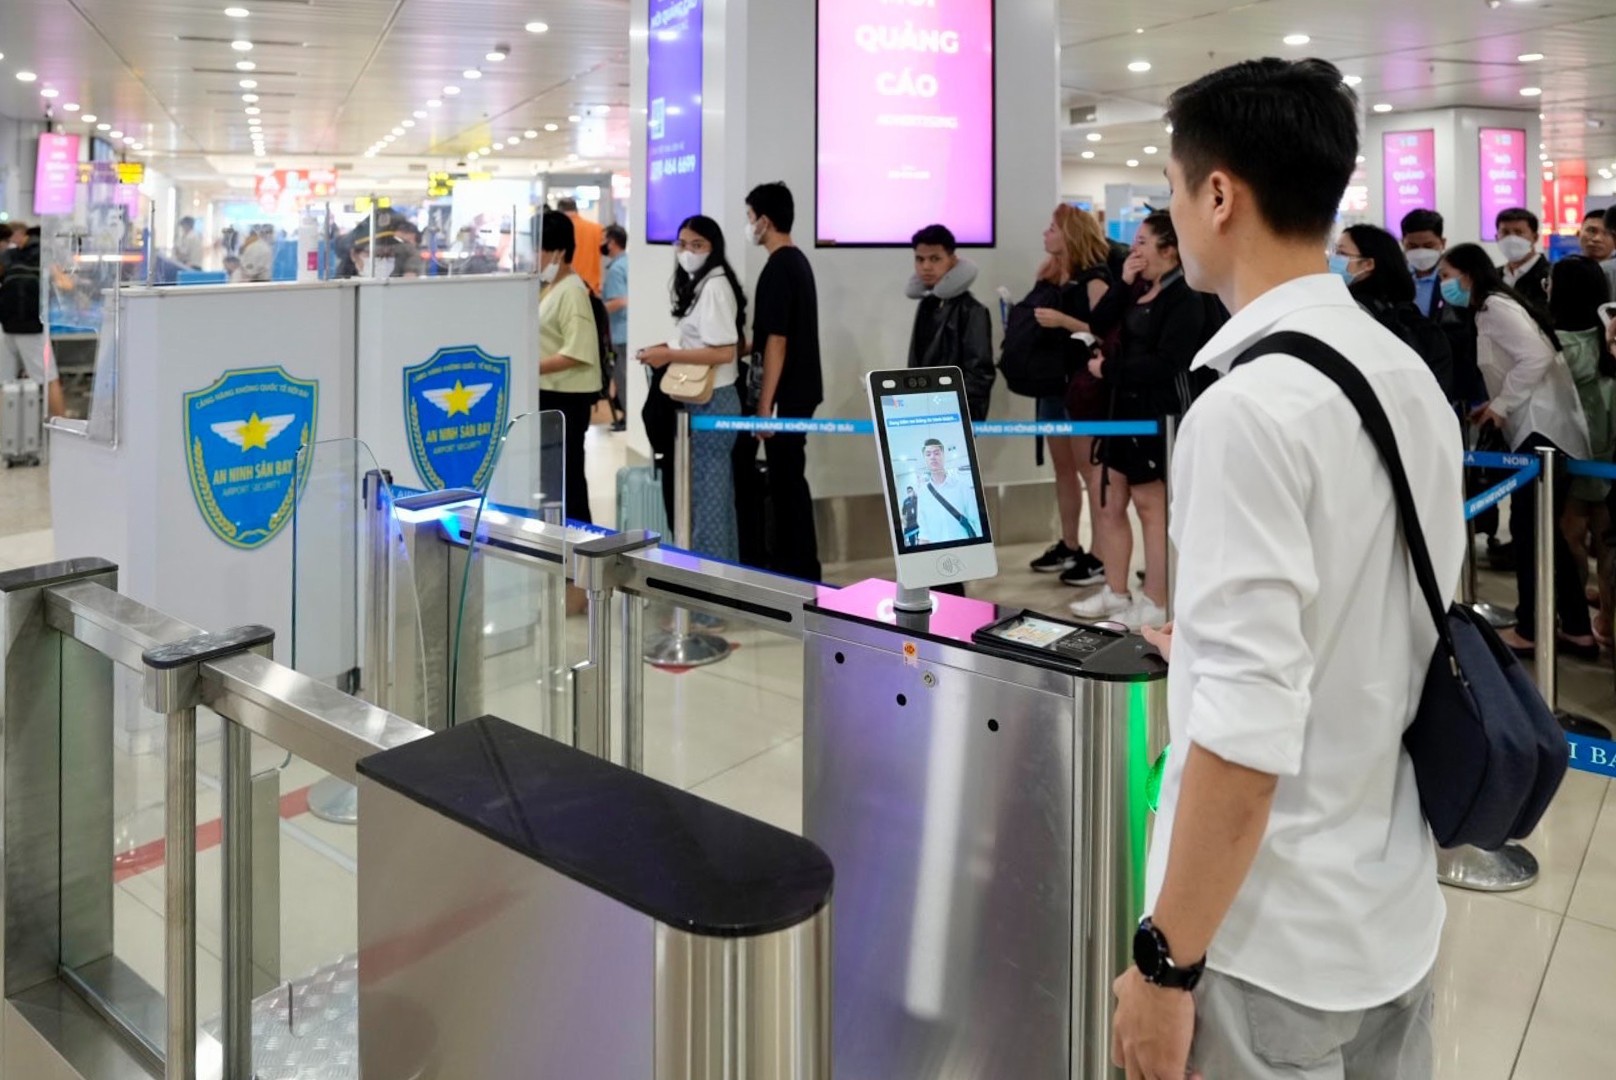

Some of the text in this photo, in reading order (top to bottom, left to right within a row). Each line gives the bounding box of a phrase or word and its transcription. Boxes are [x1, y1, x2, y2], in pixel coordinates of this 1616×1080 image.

[854, 19, 960, 54] QUẢNG
[876, 66, 938, 98] CÁO
[715, 420, 730, 429] AN
[731, 420, 755, 430] NINH
[212, 468, 227, 485] AN
[228, 465, 254, 482] NINH
[275, 459, 294, 476] BAY
